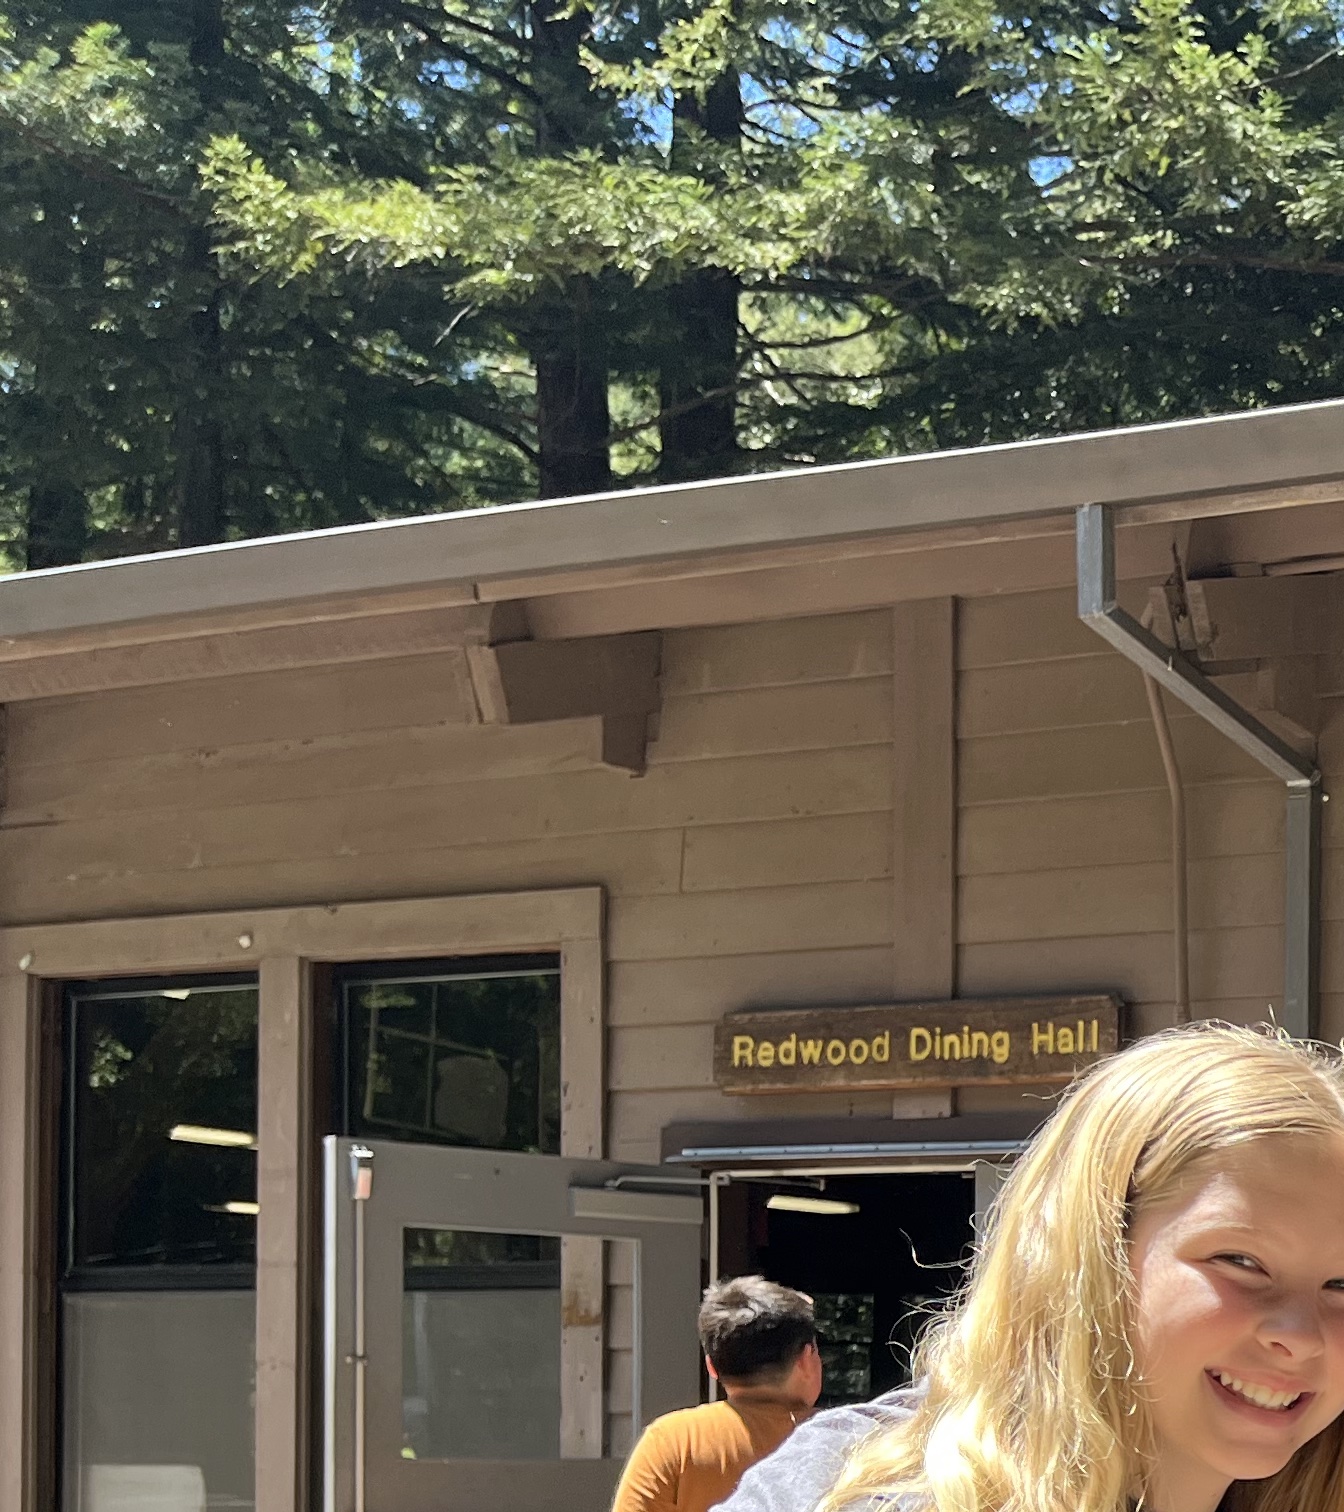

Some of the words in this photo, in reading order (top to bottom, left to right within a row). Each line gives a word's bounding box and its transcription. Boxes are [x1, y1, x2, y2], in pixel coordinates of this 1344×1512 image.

[733, 1030, 890, 1068] Redwood
[909, 1025, 1010, 1064] Dining
[1031, 1018, 1099, 1055] Hall
